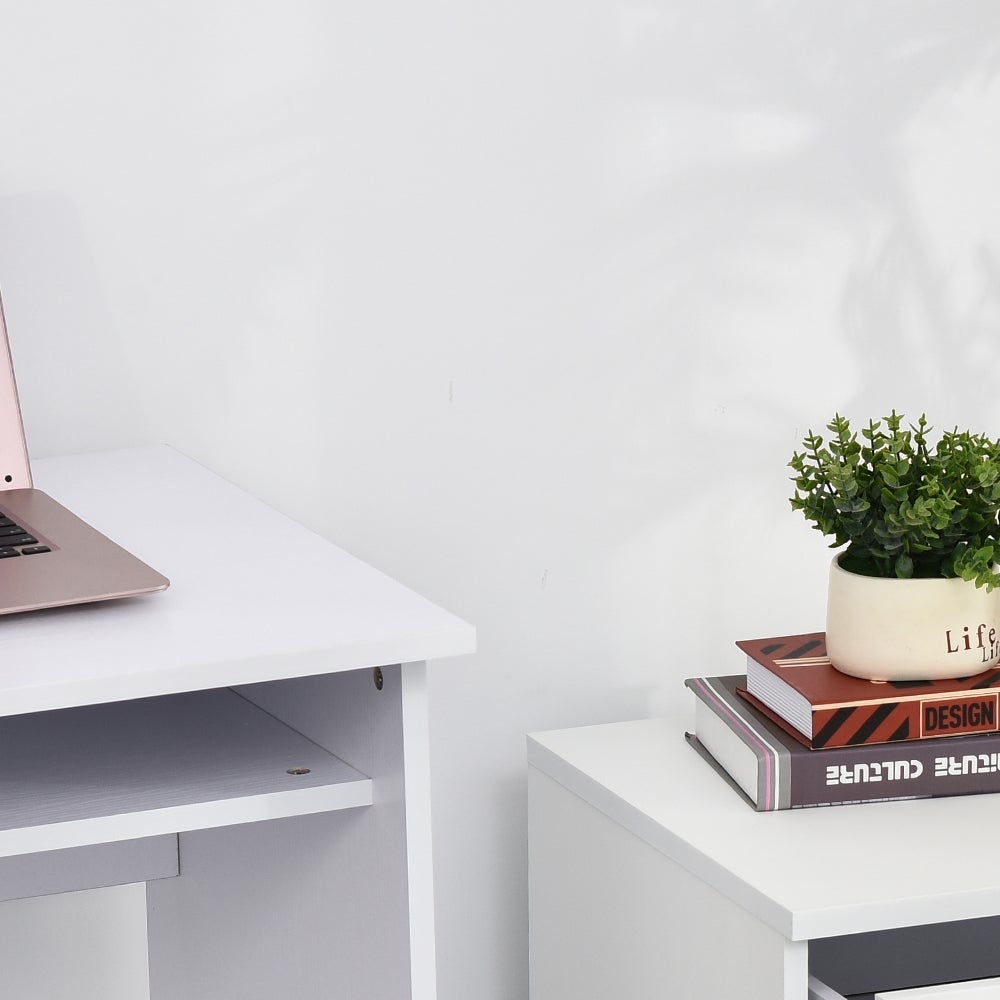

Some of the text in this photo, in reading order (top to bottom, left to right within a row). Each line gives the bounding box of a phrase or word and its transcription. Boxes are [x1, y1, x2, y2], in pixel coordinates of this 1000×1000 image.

[945, 623, 996, 654] Life
[925, 701, 994, 731] DESIGN
[826, 759, 924, 786] CULTURE
